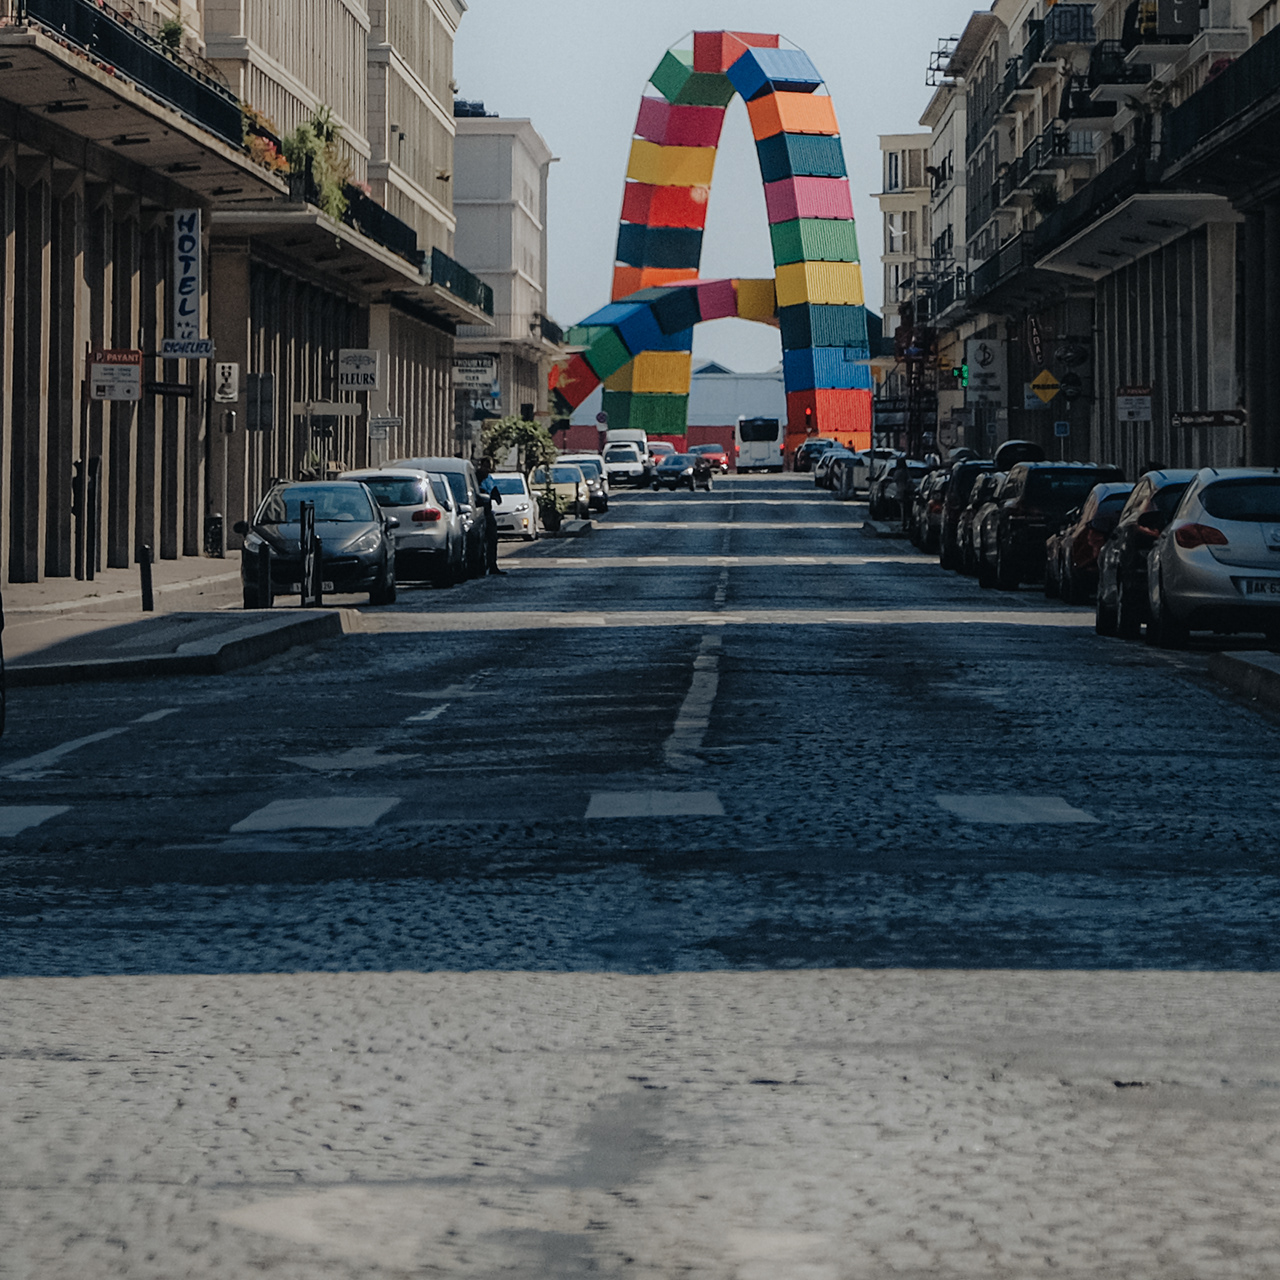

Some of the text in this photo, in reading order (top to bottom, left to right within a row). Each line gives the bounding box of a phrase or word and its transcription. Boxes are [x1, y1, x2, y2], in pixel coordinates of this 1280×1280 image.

[177, 211, 197, 317] HOTEL
[180, 330, 194, 339] LE
[1030, 317, 1043, 363] TABAC
[163, 340, 213, 354] RICHELIEU
[106, 353, 140, 362] PAYANT
[340, 372, 376, 386] FLEURS
